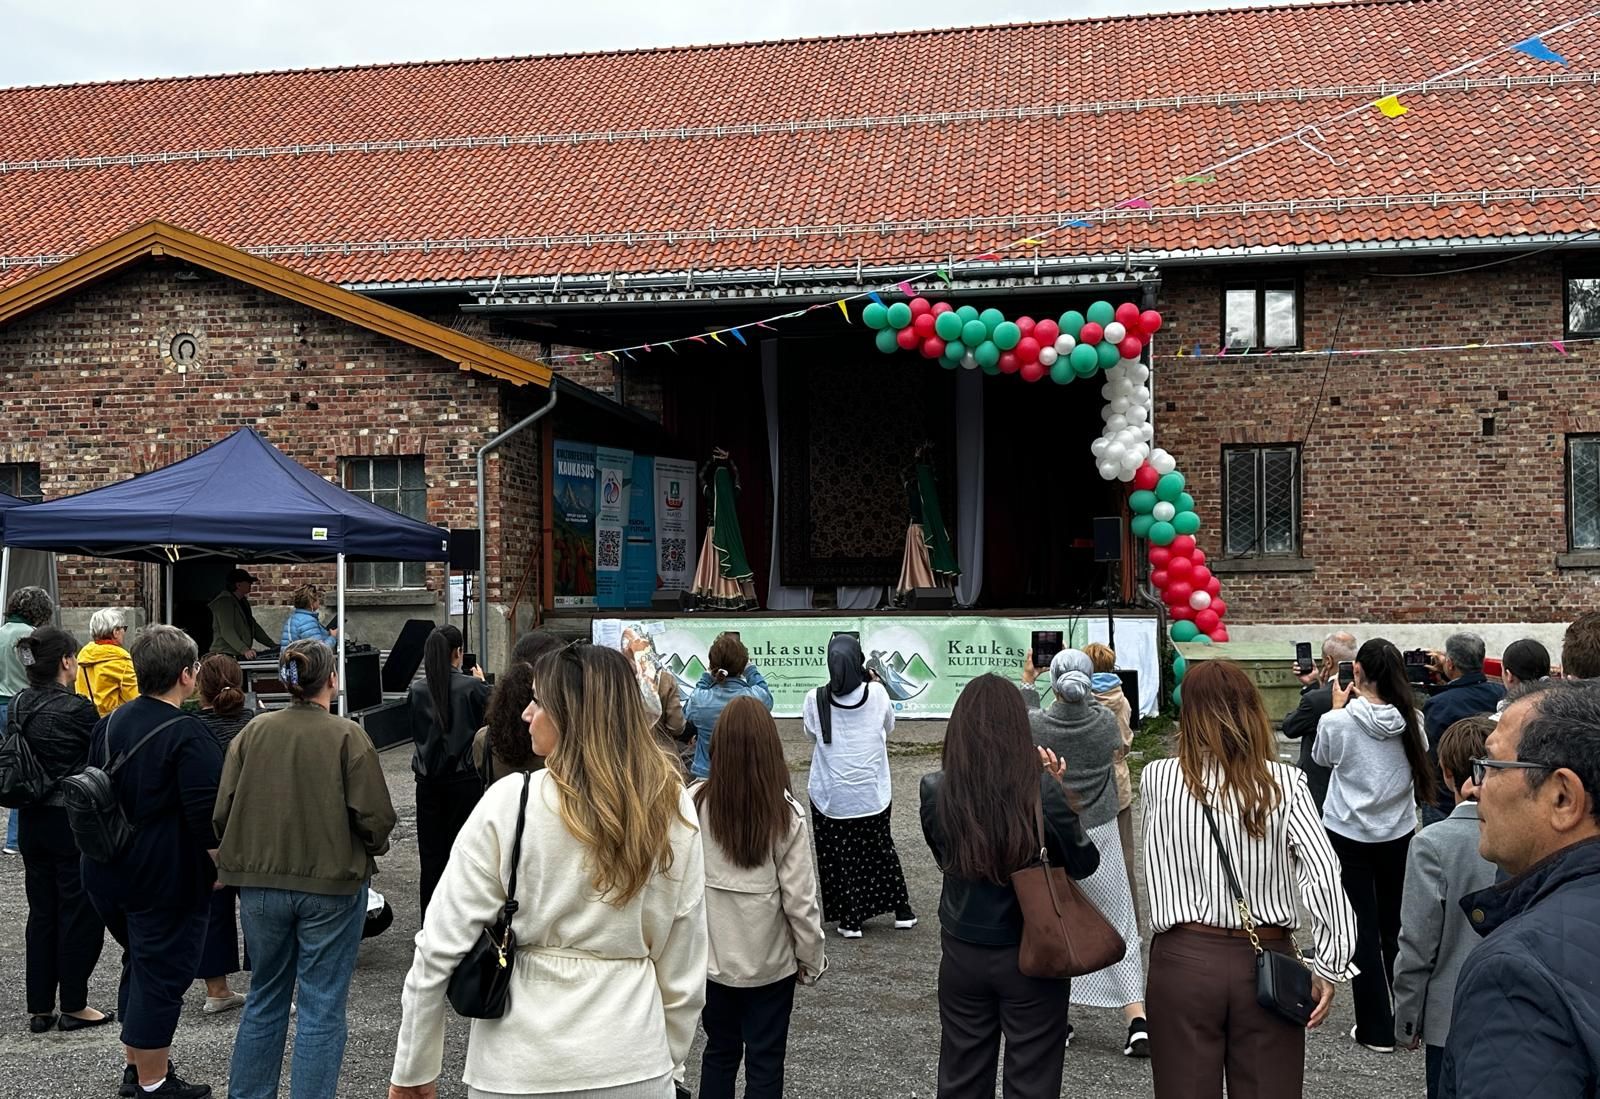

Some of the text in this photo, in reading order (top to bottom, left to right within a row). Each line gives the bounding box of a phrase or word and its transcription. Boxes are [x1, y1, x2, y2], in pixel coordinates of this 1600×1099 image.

[558, 461, 595, 479] KAUKASUS
[752, 641, 825, 655] ukasus
[947, 640, 1025, 657] Kaukas
[751, 657, 826, 667] URFESTIVAL
[947, 657, 1025, 668] KULTURFEST
